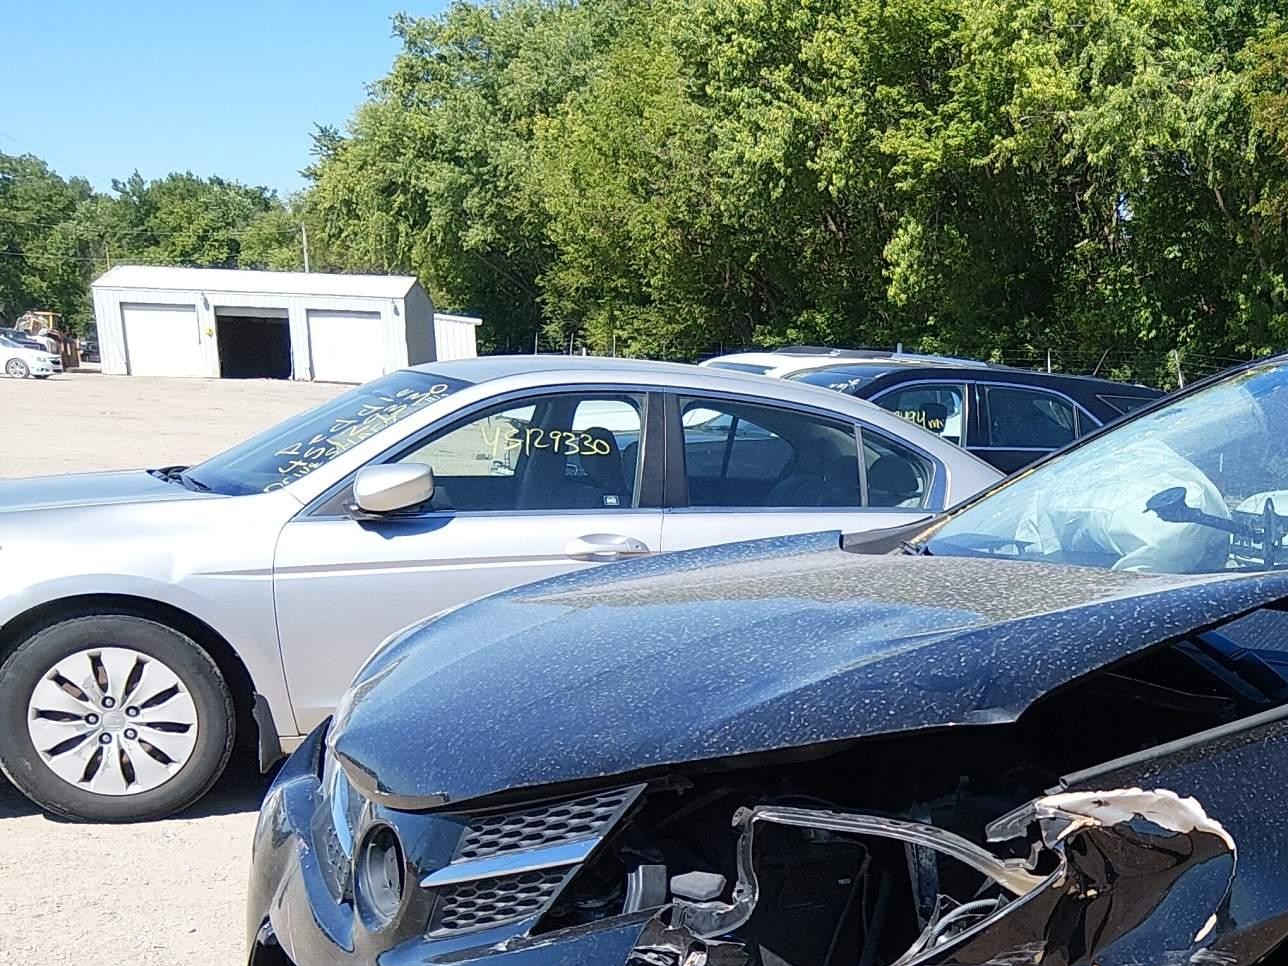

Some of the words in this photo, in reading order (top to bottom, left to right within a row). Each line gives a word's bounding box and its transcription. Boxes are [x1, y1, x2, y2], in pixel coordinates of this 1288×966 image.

[274, 388, 414, 457] Peddle
[278, 383, 449, 474] 45129330
[481, 426, 610, 457] 45129330
